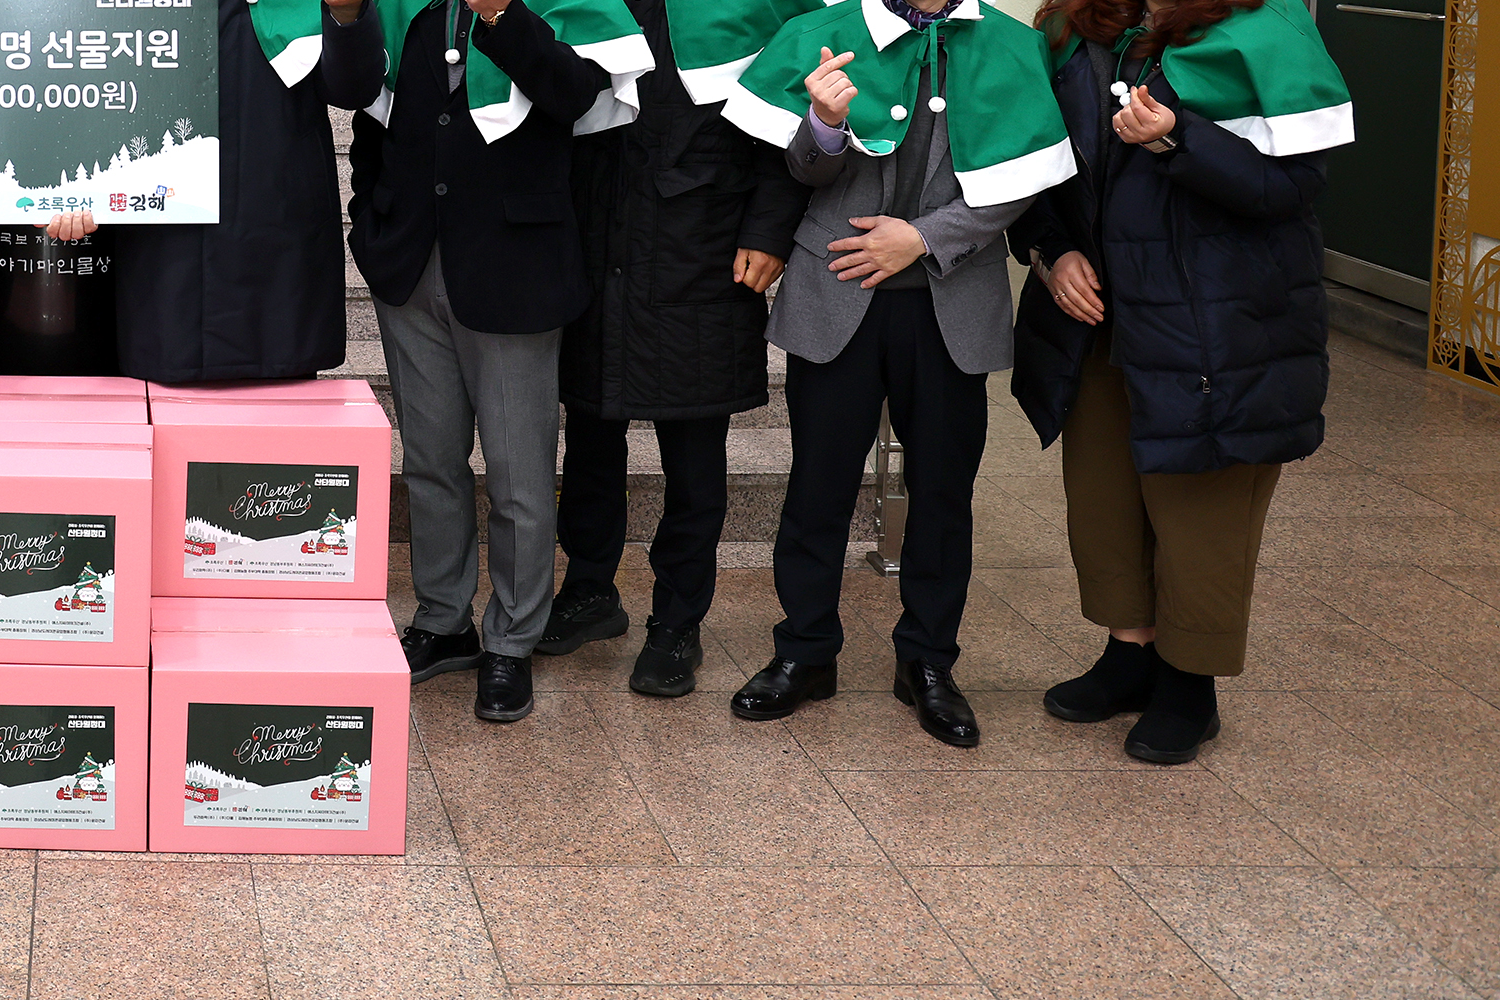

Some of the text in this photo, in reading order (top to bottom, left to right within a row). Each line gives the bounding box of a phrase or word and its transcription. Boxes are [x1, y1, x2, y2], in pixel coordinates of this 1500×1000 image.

[41, 28, 180, 71] 선물지원
[37, 193, 165, 213] 초록우산 김해
[0, 232, 28, 246] 국보
[247, 480, 304, 500] Merry
[229, 493, 311, 521] Christmas
[252, 722, 315, 743] Merry
[233, 736, 322, 765] Christmas
